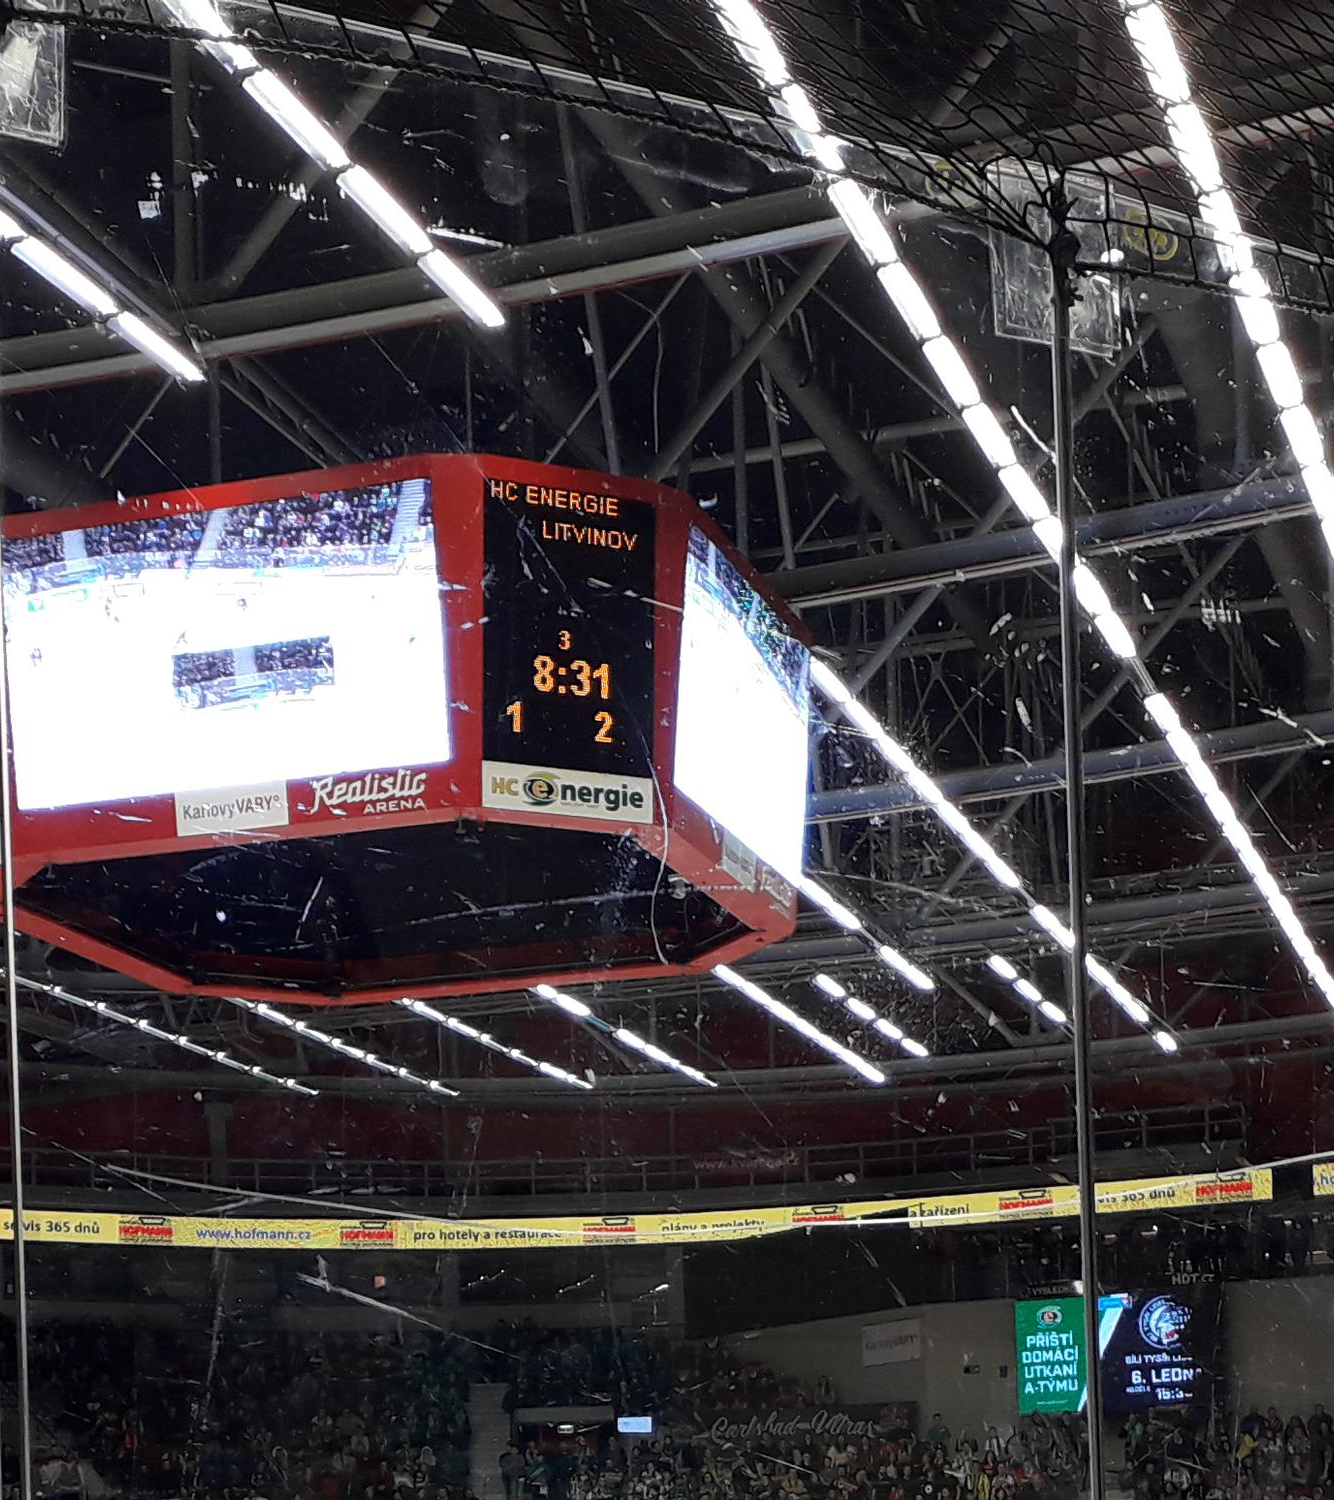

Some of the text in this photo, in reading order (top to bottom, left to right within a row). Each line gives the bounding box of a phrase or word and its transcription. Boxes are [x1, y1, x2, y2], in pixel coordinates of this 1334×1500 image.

[490, 479, 620, 517] HC ENERGIE
[542, 520, 639, 551] LITVINOV
[558, 630, 571, 650] 3
[533, 654, 610, 699] 8:31
[507, 701, 613, 743] 1 2
[307, 768, 427, 815] Realistic
[491, 776, 519, 797] HC
[363, 797, 426, 815] ARENA
[45, 1220, 71, 1233] 365
[75, 1220, 100, 1234] dnů
[196, 1228, 312, 1241] www.hofmann.cz
[414, 1231, 436, 1242] pro
[439, 1229, 479, 1242] hotely
[1026, 1330, 1073, 1348] PŘÍŠTÍ
[1022, 1344, 1079, 1364] DOMÁCÍ
[1024, 1361, 1078, 1379] UTKANÍ
[1131, 1367, 1203, 1385] 6. LEDN
[1024, 1376, 1079, 1395] A-TÝMU
